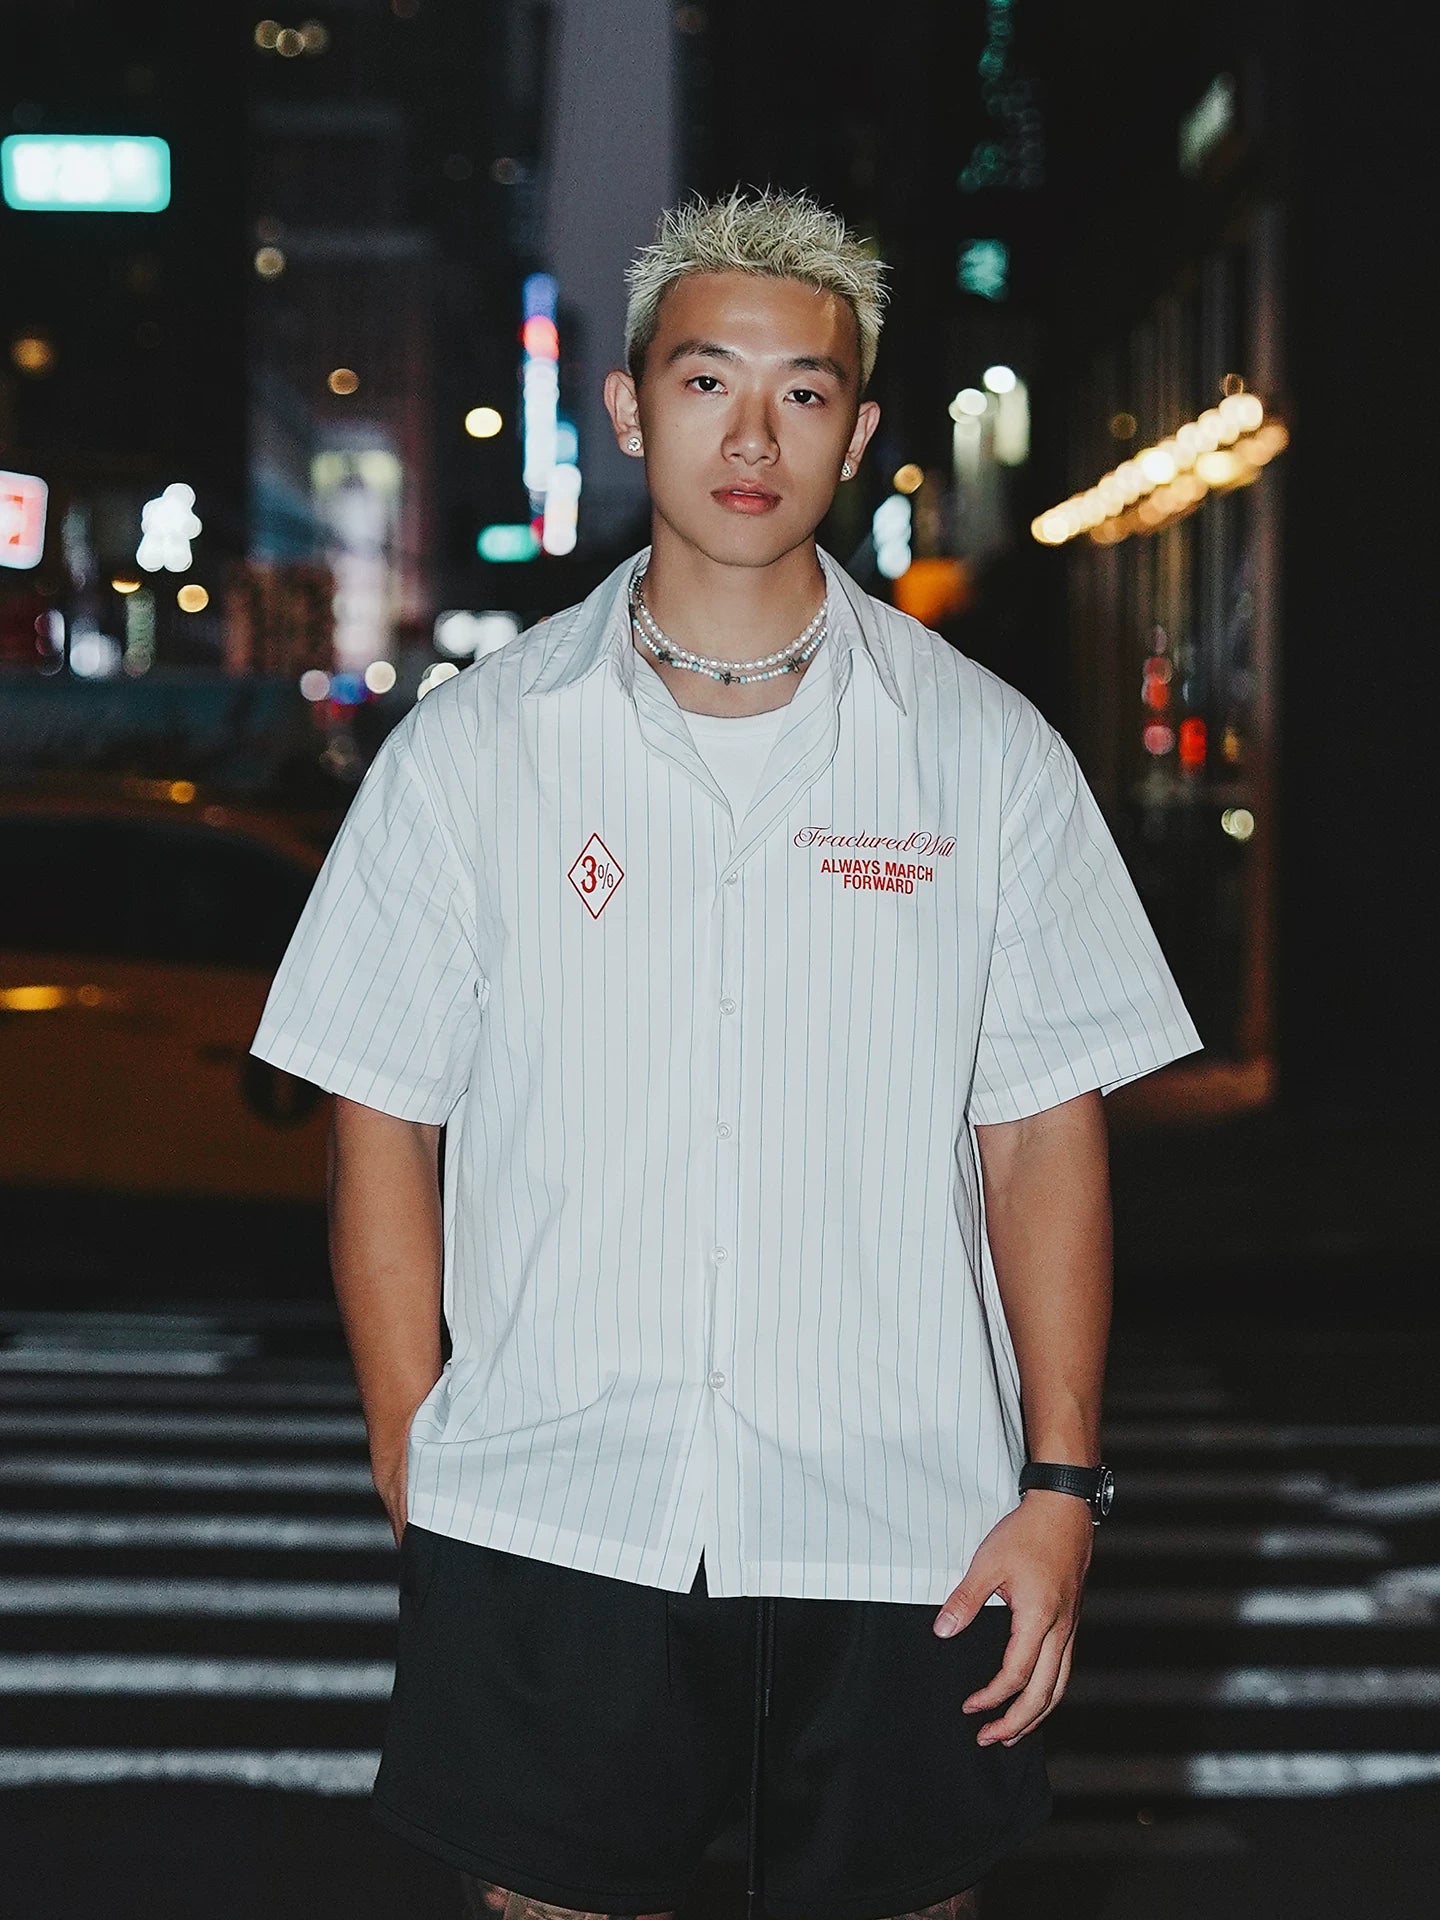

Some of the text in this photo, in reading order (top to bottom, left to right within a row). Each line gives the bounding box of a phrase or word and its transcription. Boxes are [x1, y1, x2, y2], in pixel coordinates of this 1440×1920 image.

[580, 855, 614, 893] 3%
[821, 859, 933, 882] ALWAYS MARCH
[843, 874, 914, 894] FORWARD
